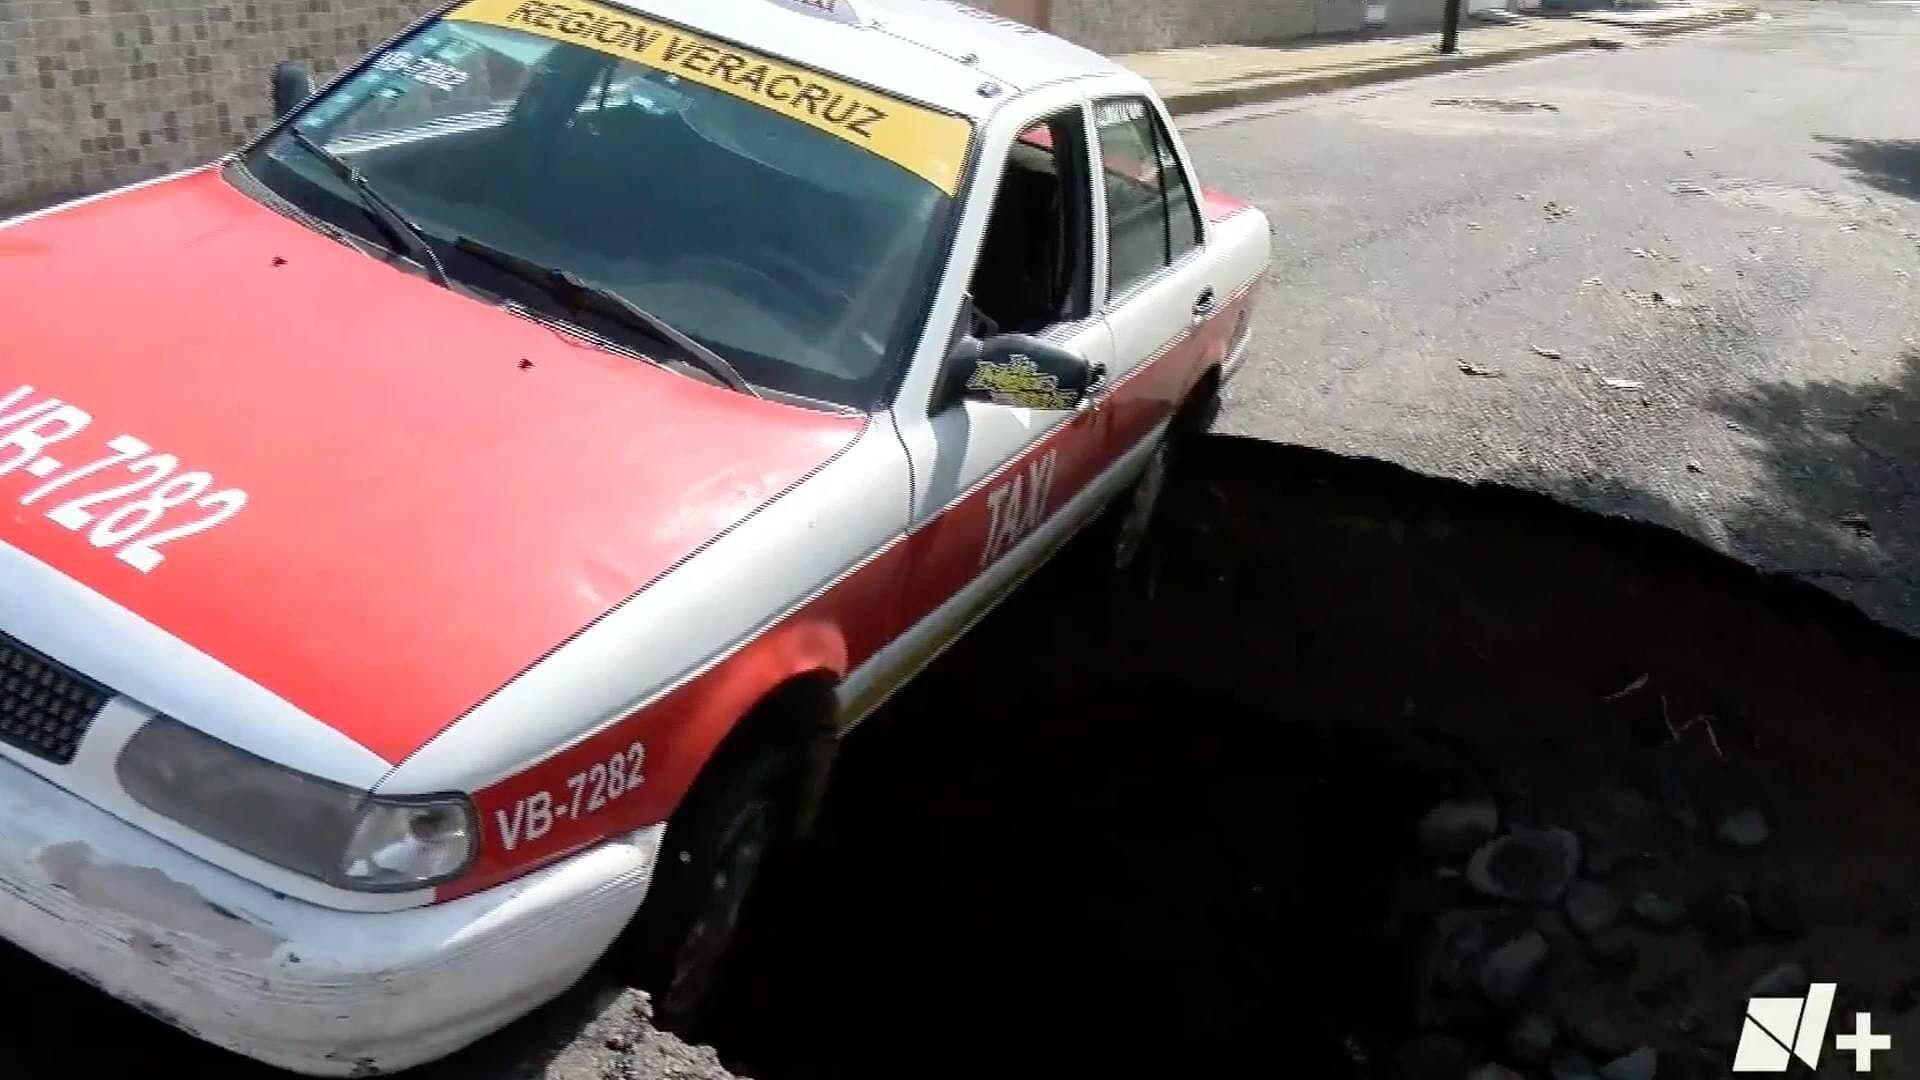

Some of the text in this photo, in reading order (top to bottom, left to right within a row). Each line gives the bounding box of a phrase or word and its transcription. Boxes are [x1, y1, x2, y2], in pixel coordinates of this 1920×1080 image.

[506, 0, 889, 138] REGION VERACRUZ
[979, 448, 1057, 568] TAXI
[495, 740, 646, 851] VB-7282
